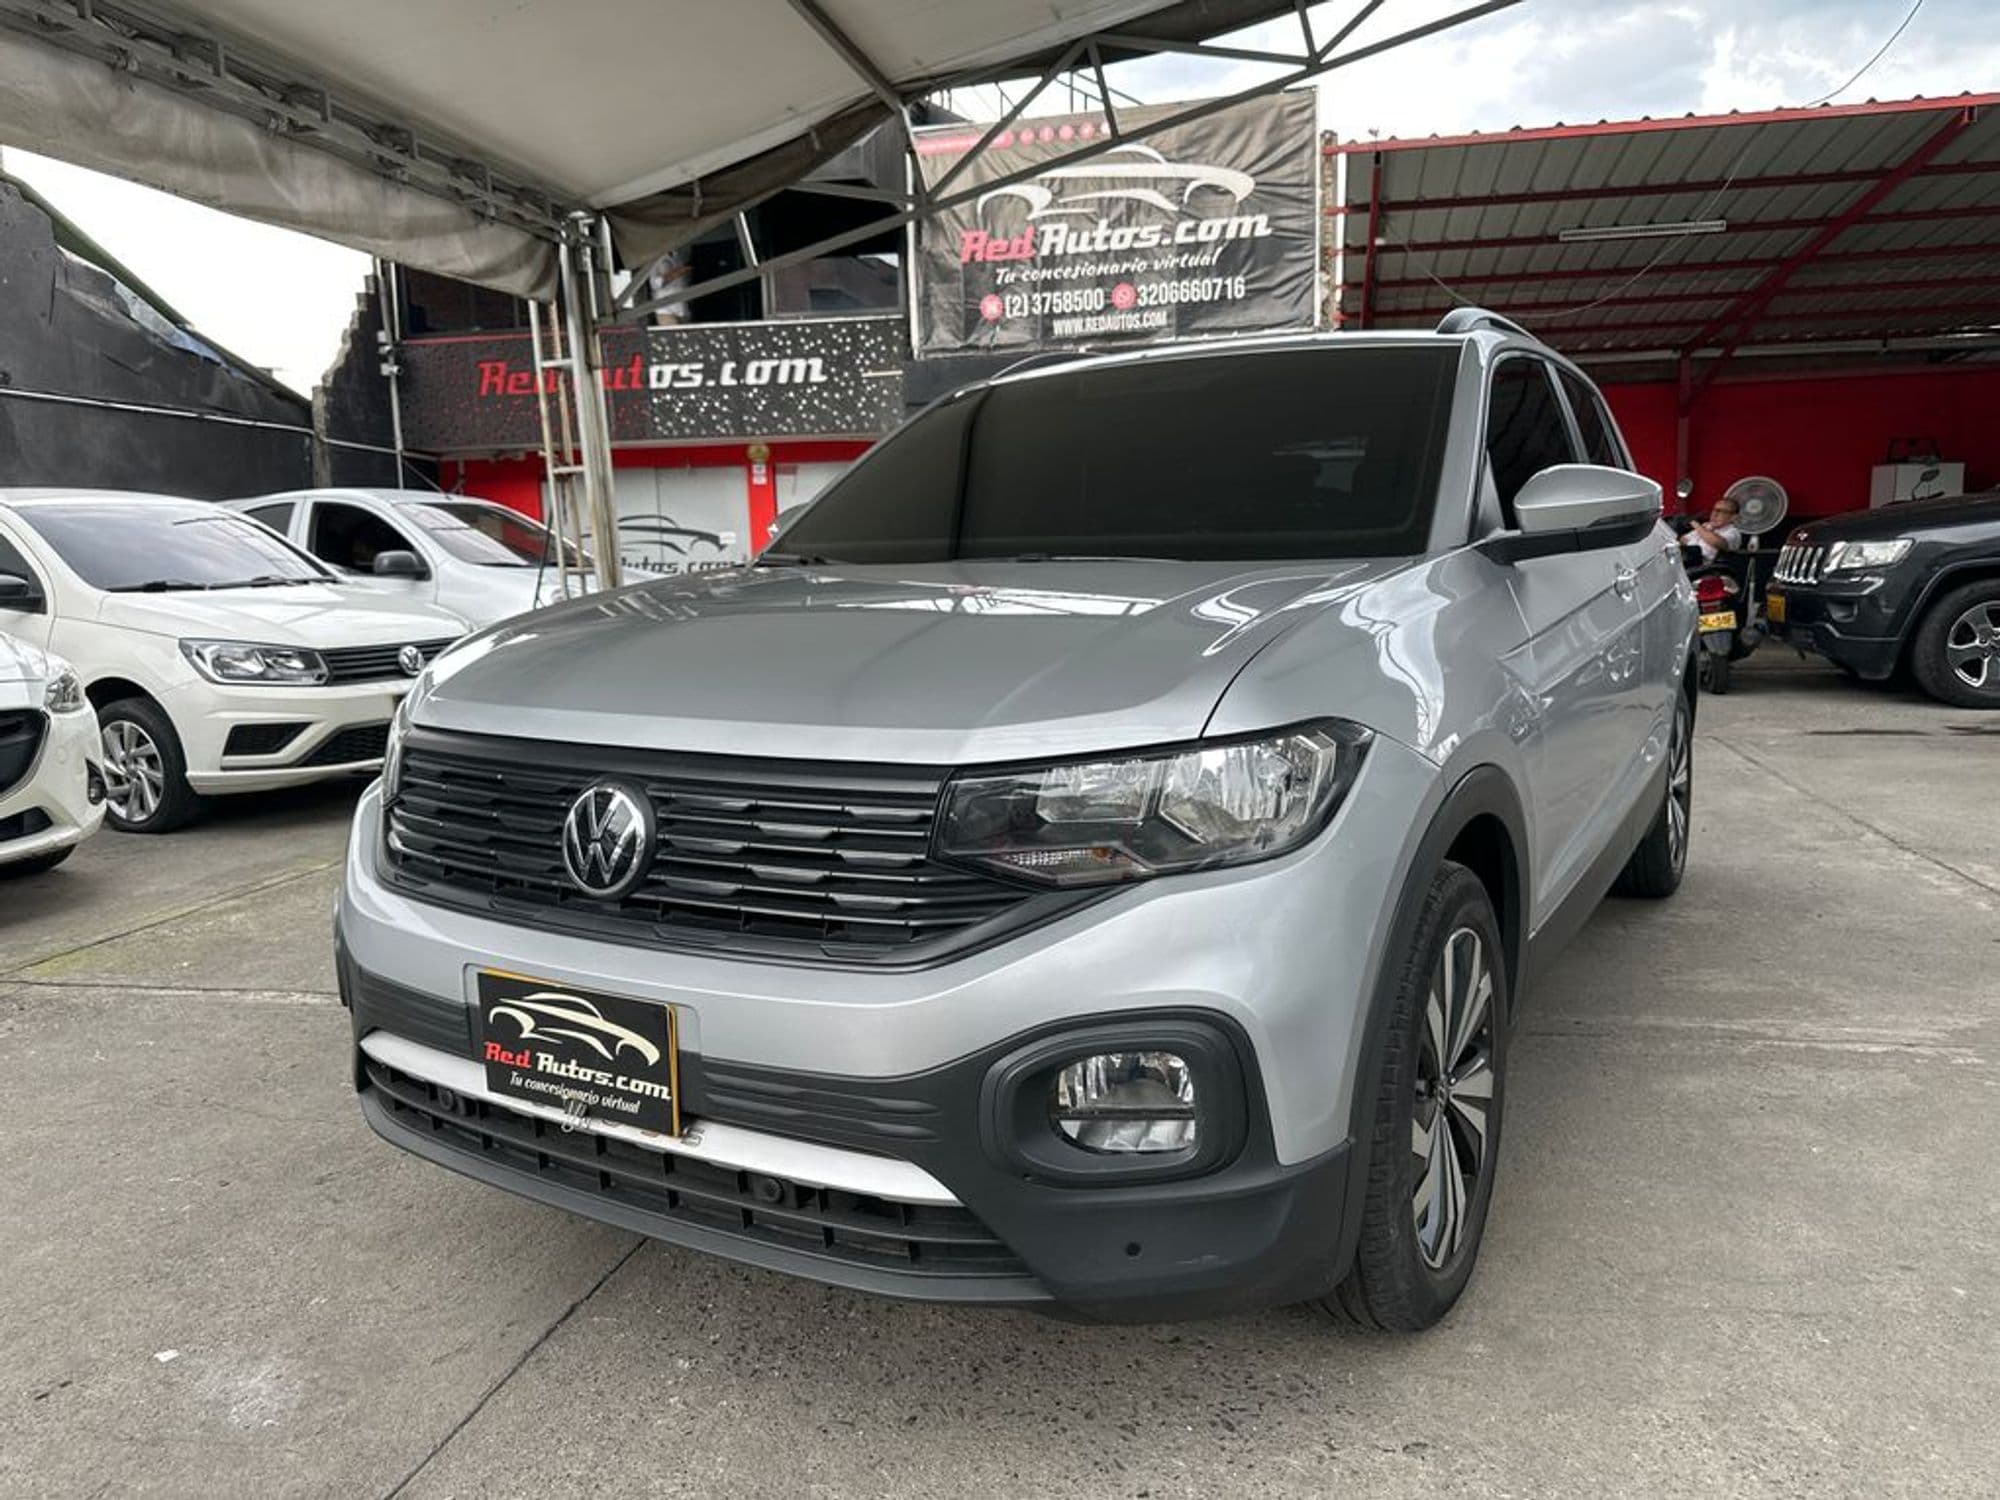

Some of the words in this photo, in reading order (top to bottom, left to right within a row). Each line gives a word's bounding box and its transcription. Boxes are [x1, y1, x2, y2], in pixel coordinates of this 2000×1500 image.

[961, 225, 1036, 263] Red
[1038, 213, 1272, 256] Autos.com
[996, 267, 1016, 284] Tu
[1021, 257, 1148, 281] concesionario
[1153, 246, 1223, 271] virtual
[1137, 276, 1245, 307] 3206660716
[1053, 311, 1167, 337] WWW.REDAUTOS.COM
[484, 1041, 532, 1069] Red
[536, 1052, 672, 1101] Autos.com
[510, 1071, 523, 1087] Tu
[524, 1077, 600, 1105] concesionario
[601, 1094, 641, 1115] virtual
